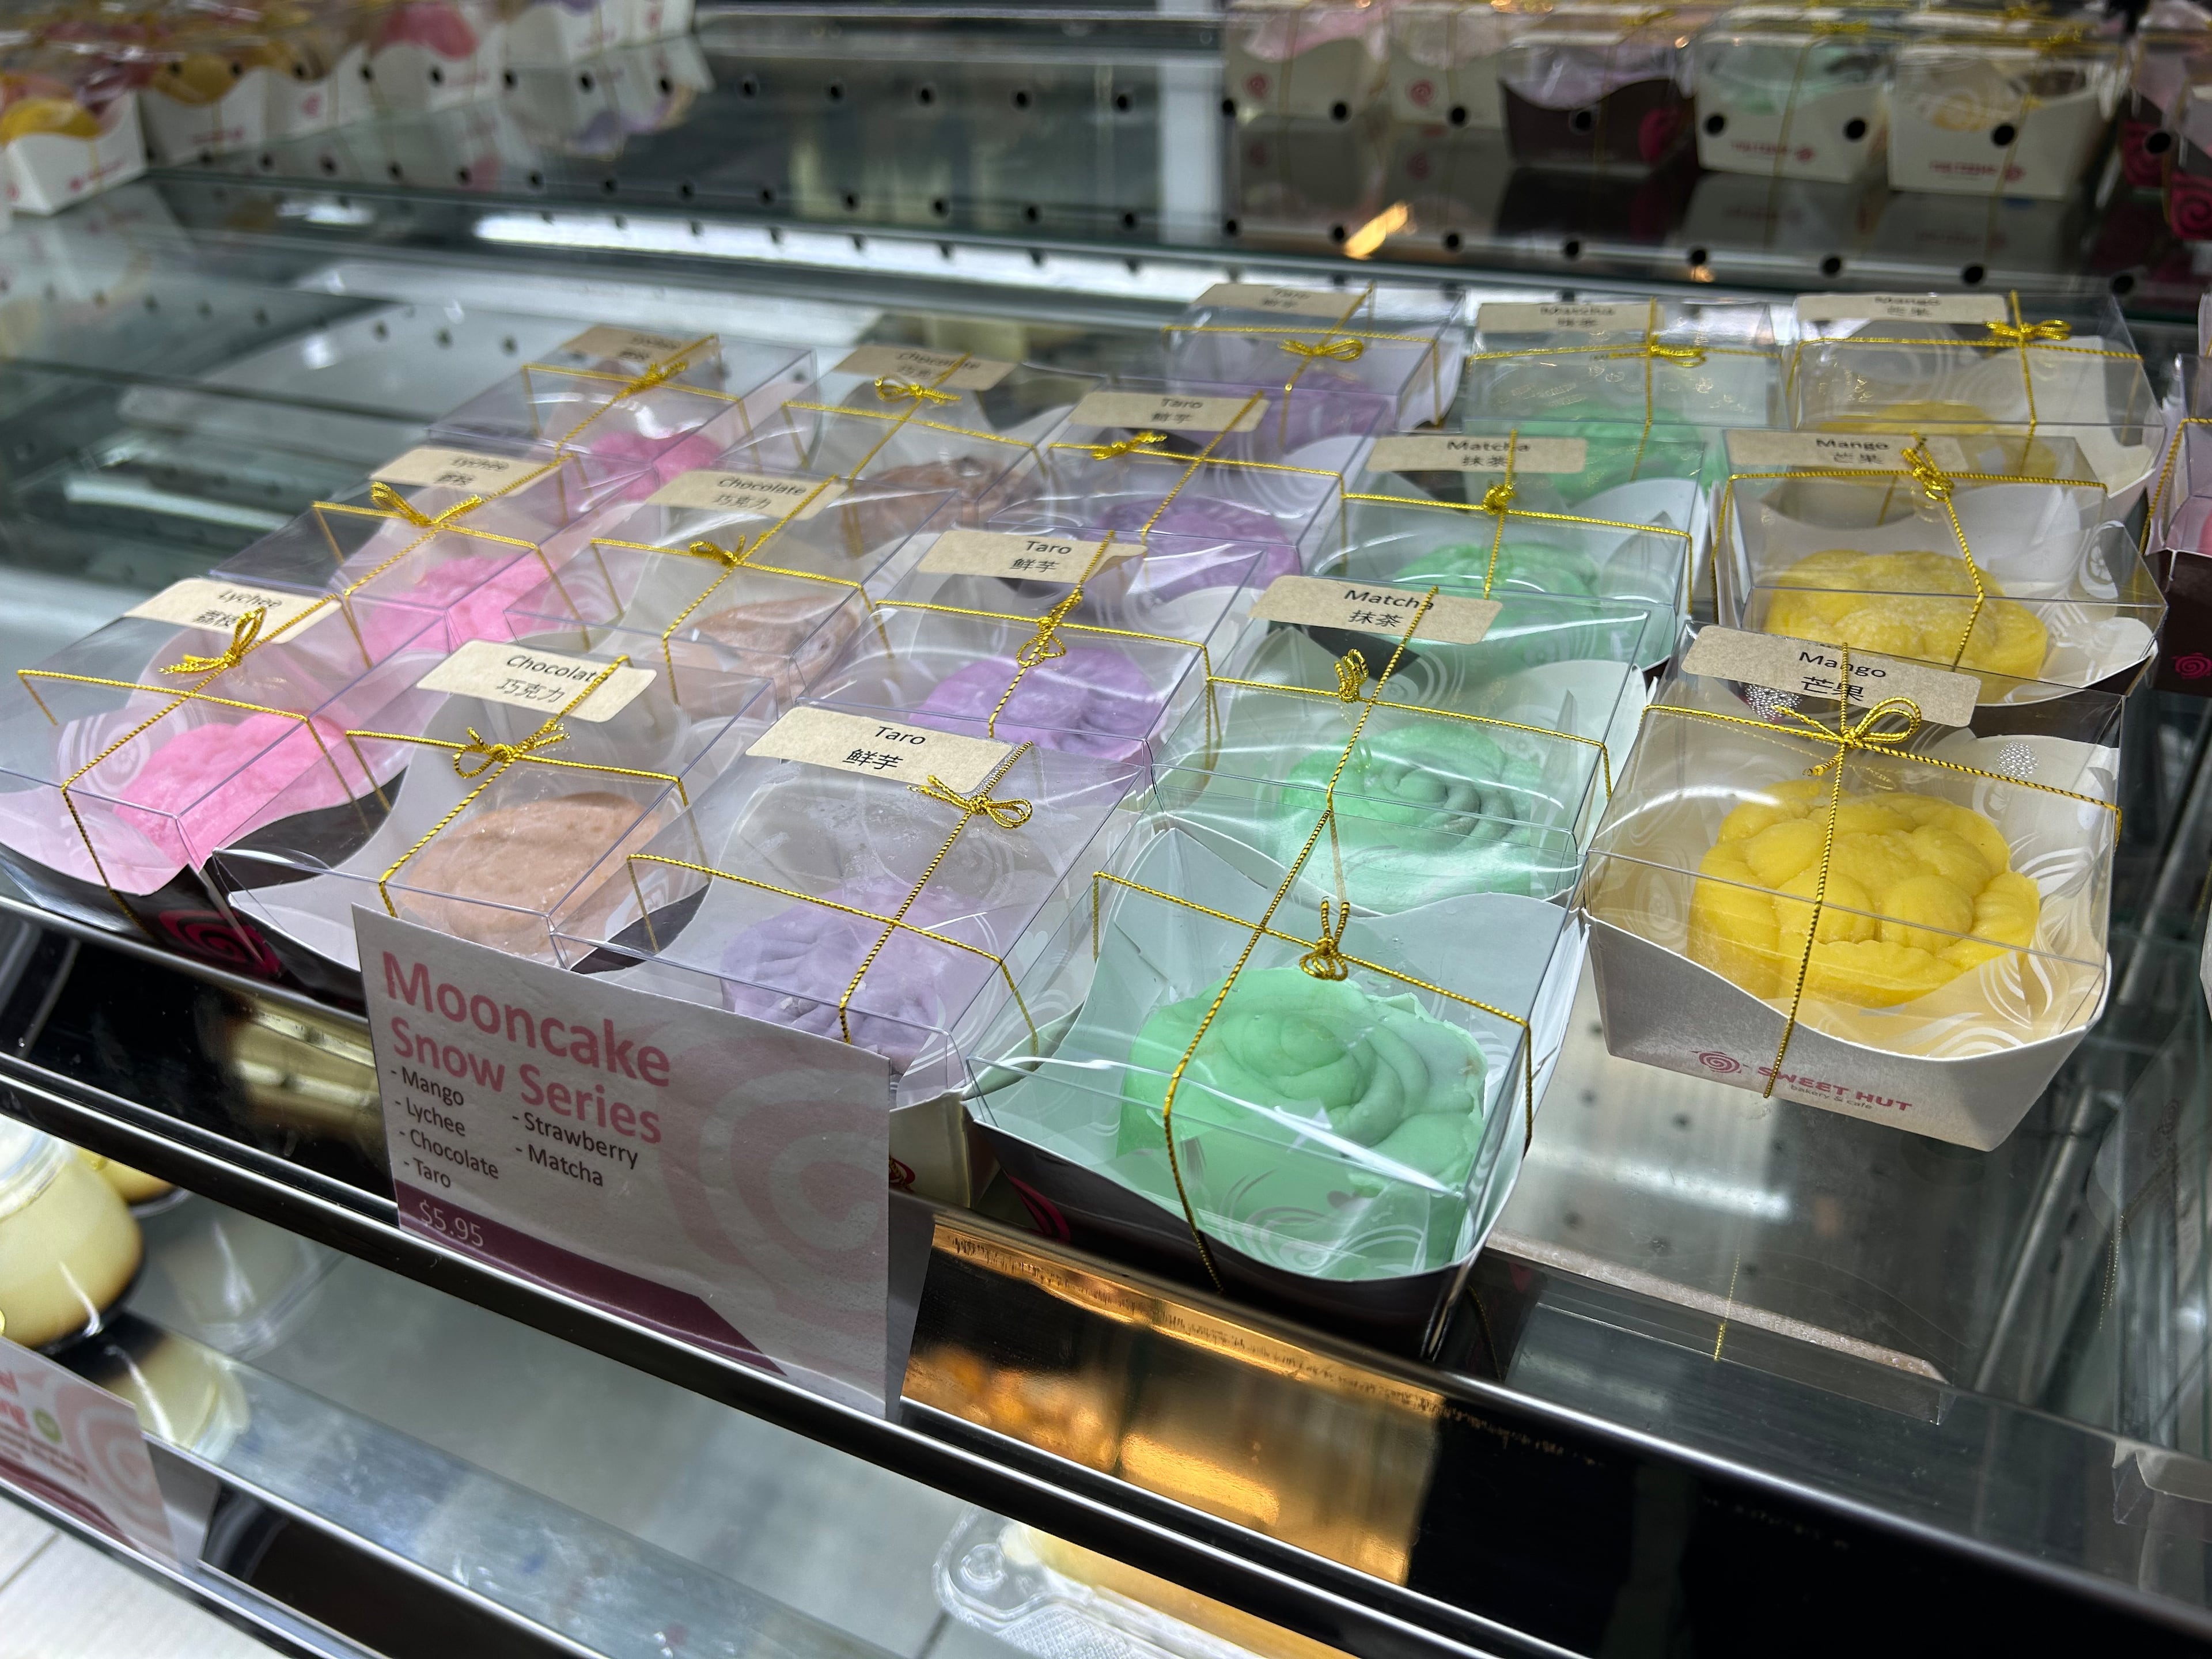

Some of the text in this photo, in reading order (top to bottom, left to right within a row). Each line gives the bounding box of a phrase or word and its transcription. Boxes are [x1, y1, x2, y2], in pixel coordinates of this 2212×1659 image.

[1815, 438, 1890, 450] Mango
[719, 476, 807, 496] Chocolate
[1026, 540, 1072, 555] Taro
[1009, 558, 1060, 573] 鲜芋
[1348, 609, 1404, 628] 抹茶
[1798, 651, 1887, 678] Mango
[495, 677, 566, 703] 巧克力
[1801, 676, 1864, 702] 芒果
[874, 726, 926, 745] Taro
[842, 748, 904, 770] 鲜芋
[382, 950, 671, 1088] Mooncake
[391, 1016, 662, 1144] Snow Series
[402, 1066, 465, 1107] Mango
[1758, 1066, 1912, 1112] SWEET HUT
[1790, 1084, 1830, 1099] bakery
[406, 1096, 466, 1138] Lychee
[410, 1128, 499, 1180] Chocolate
[524, 1112, 638, 1171] Strawberry
[412, 1157, 452, 1189] Taro
[528, 1143, 604, 1187] Matcha
[419, 1199, 484, 1248] $5.95
